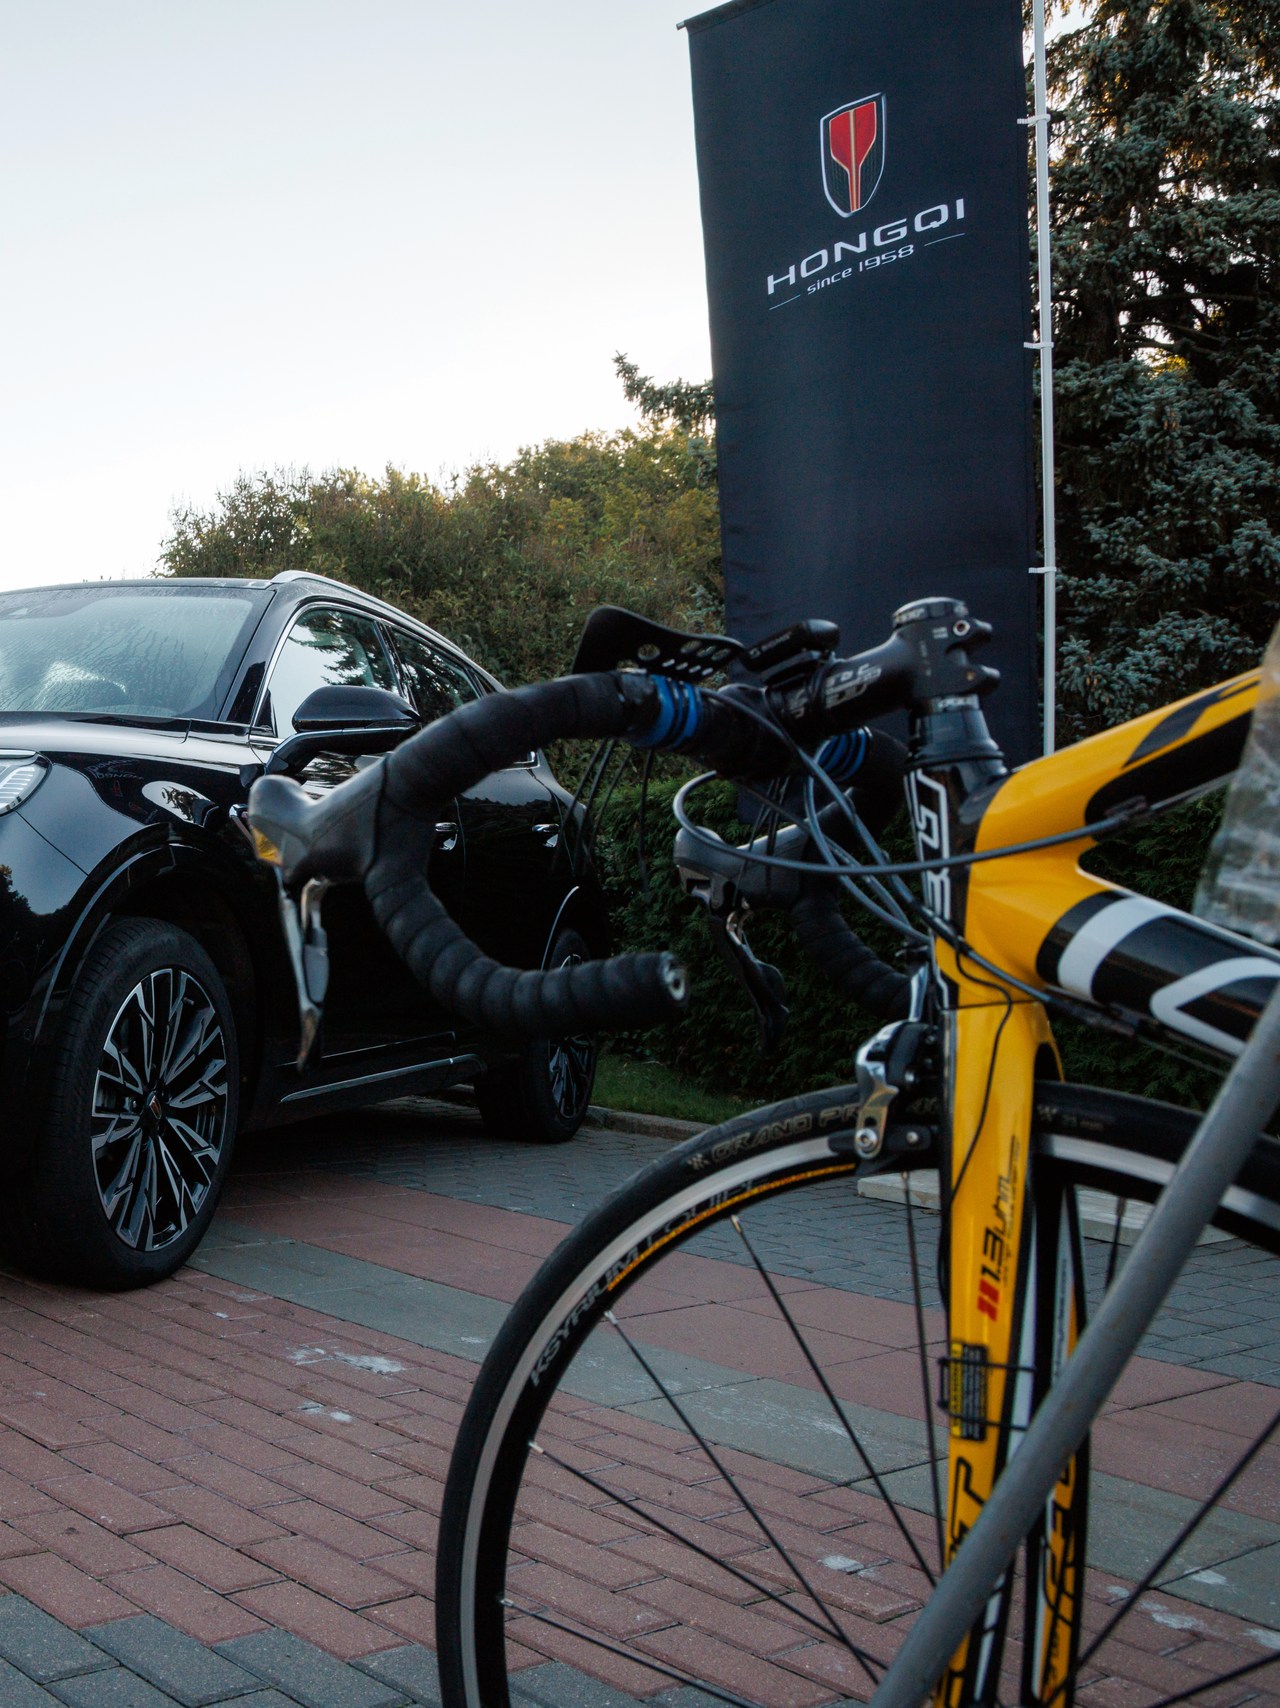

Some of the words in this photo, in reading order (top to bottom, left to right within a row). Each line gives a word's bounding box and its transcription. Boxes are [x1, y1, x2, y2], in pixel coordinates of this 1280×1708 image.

[767, 198, 965, 295] HONGQI
[807, 267, 852, 295] since
[859, 244, 914, 272] 1958
[711, 1112, 813, 1163] GRAND
